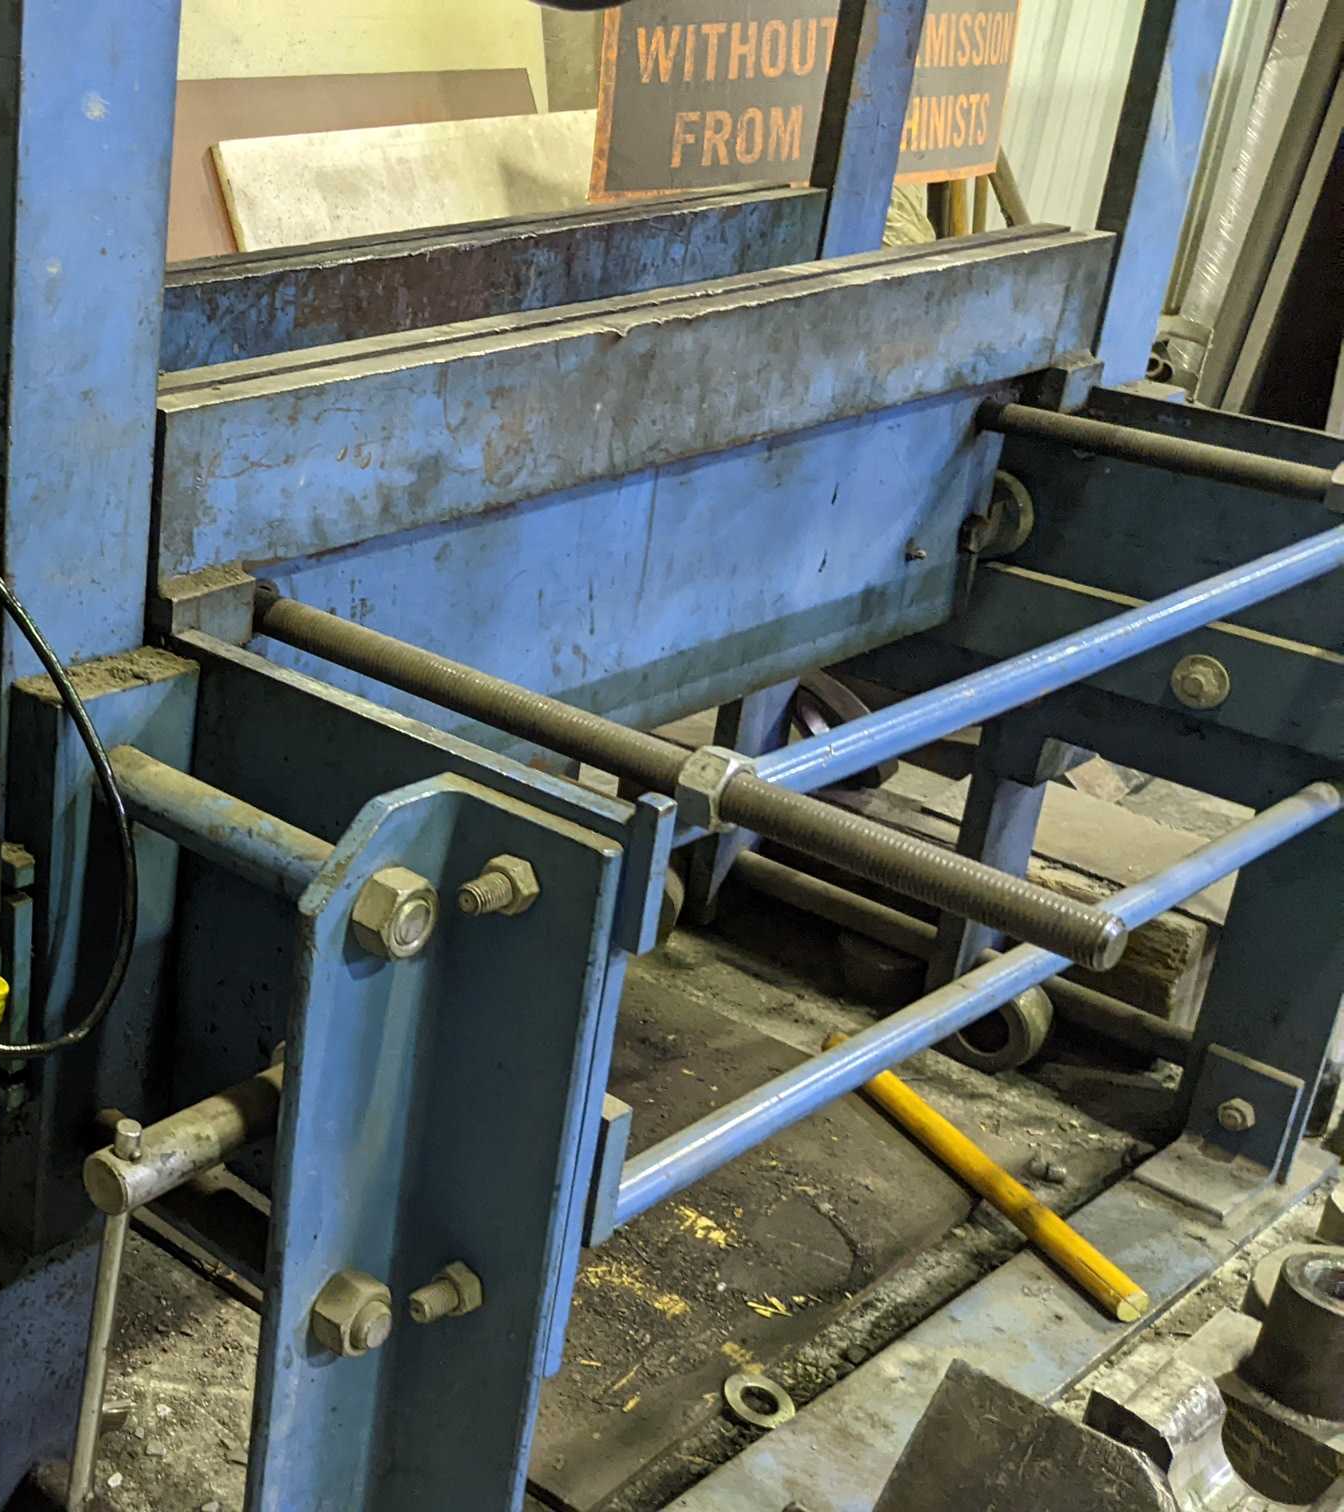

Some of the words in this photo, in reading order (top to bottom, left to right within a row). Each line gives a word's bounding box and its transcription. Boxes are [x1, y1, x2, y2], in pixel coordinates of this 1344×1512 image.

[636, 15, 838, 84] WITHOUT
[915, 11, 1015, 68] MISSION
[669, 105, 805, 169] FROM
[899, 92, 991, 153] HINISTS
